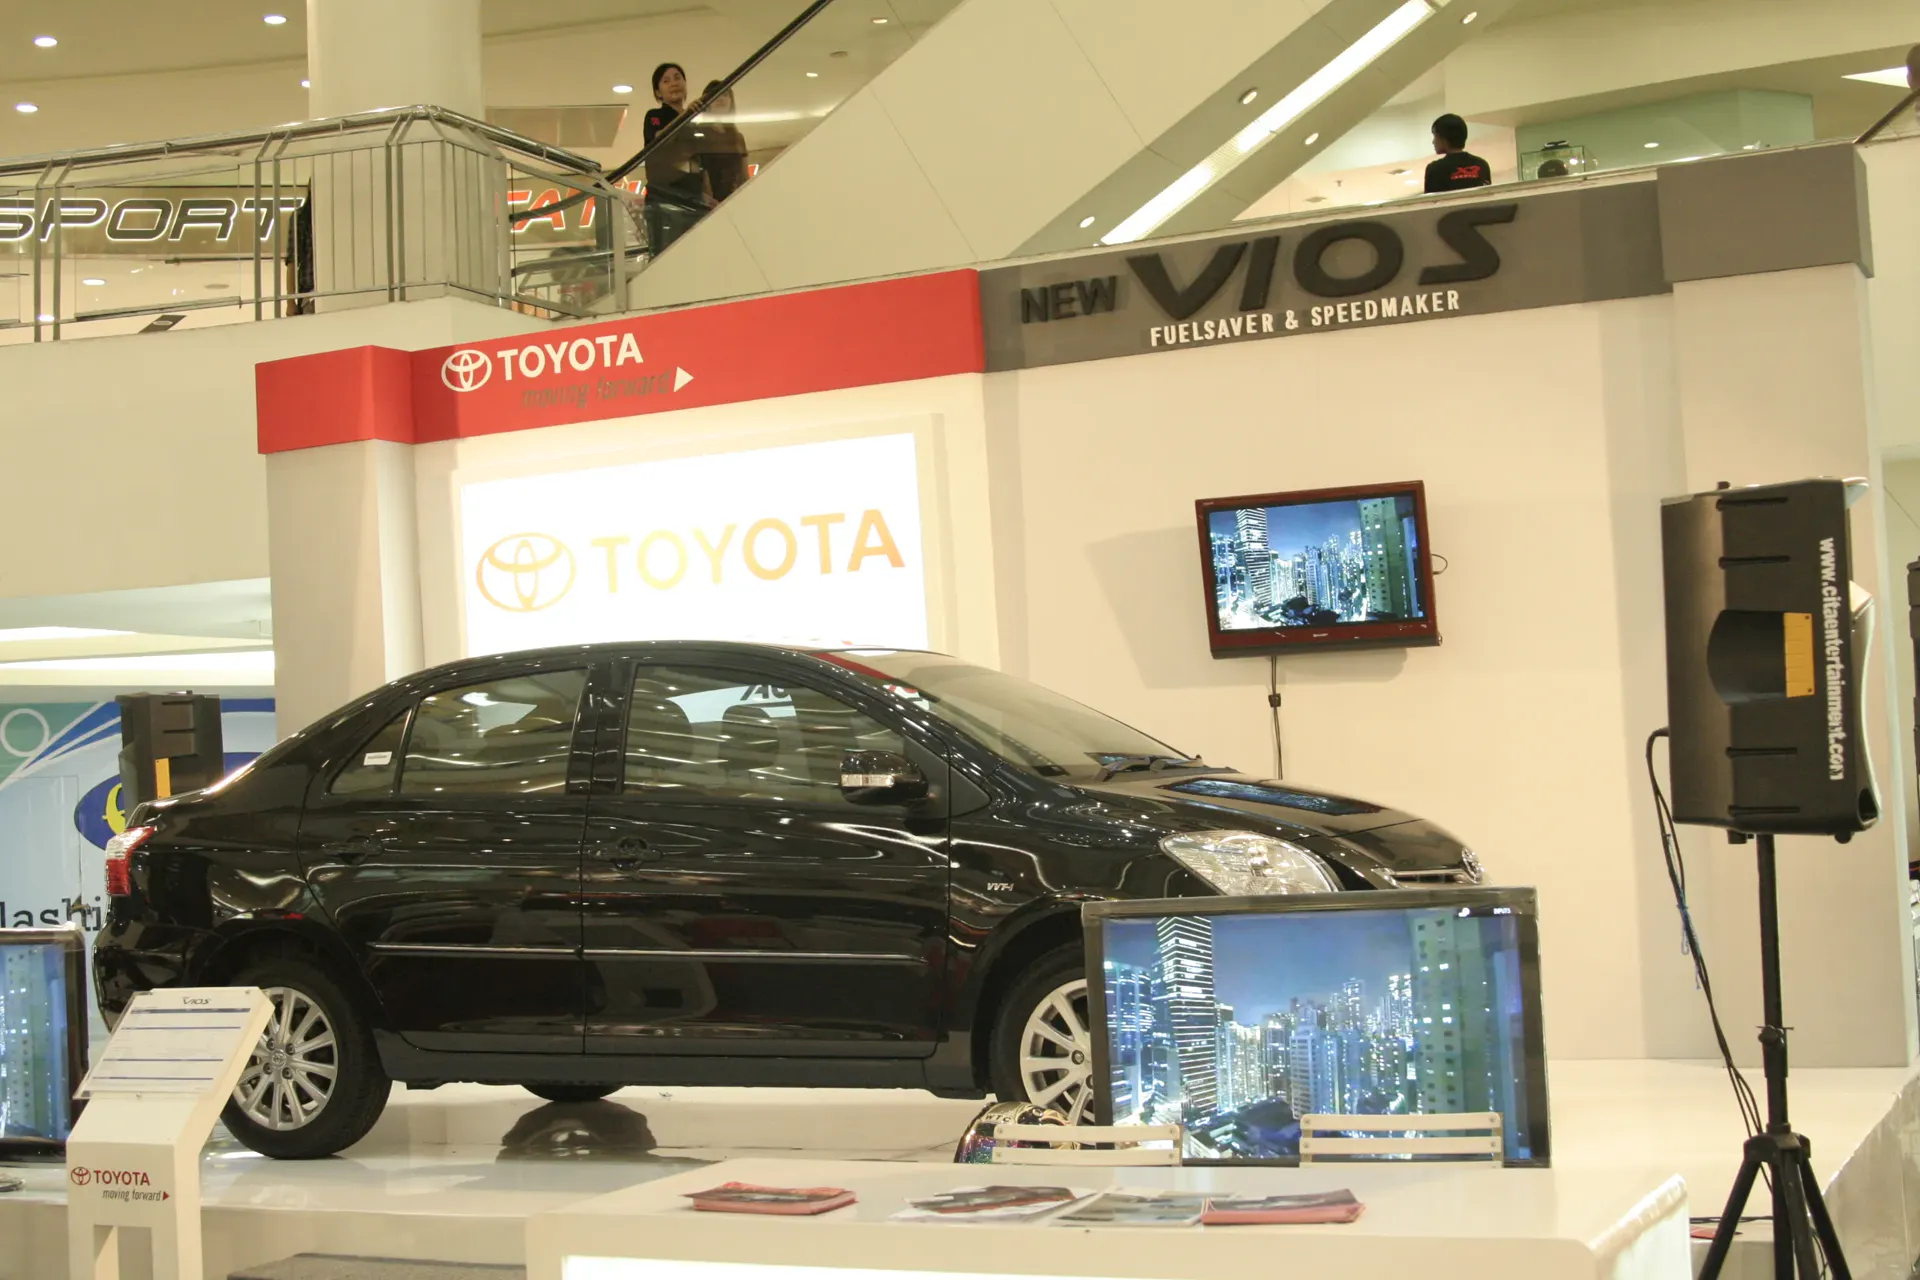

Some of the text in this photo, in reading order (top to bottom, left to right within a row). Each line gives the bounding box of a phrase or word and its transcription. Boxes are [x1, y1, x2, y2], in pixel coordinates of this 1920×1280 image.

[1019, 202, 1519, 324] NEW VIOS
[1149, 289, 1460, 348] FUELSAVER & SPEEDMAKER
[497, 332, 644, 381] TOYOTA
[521, 368, 672, 409] moving forward
[591, 508, 906, 594] TOYOTA
[1819, 537, 1847, 781] www.citaentertainment.com
[93, 1170, 150, 1186] TOYOTA
[102, 1188, 162, 1202] moving forward
